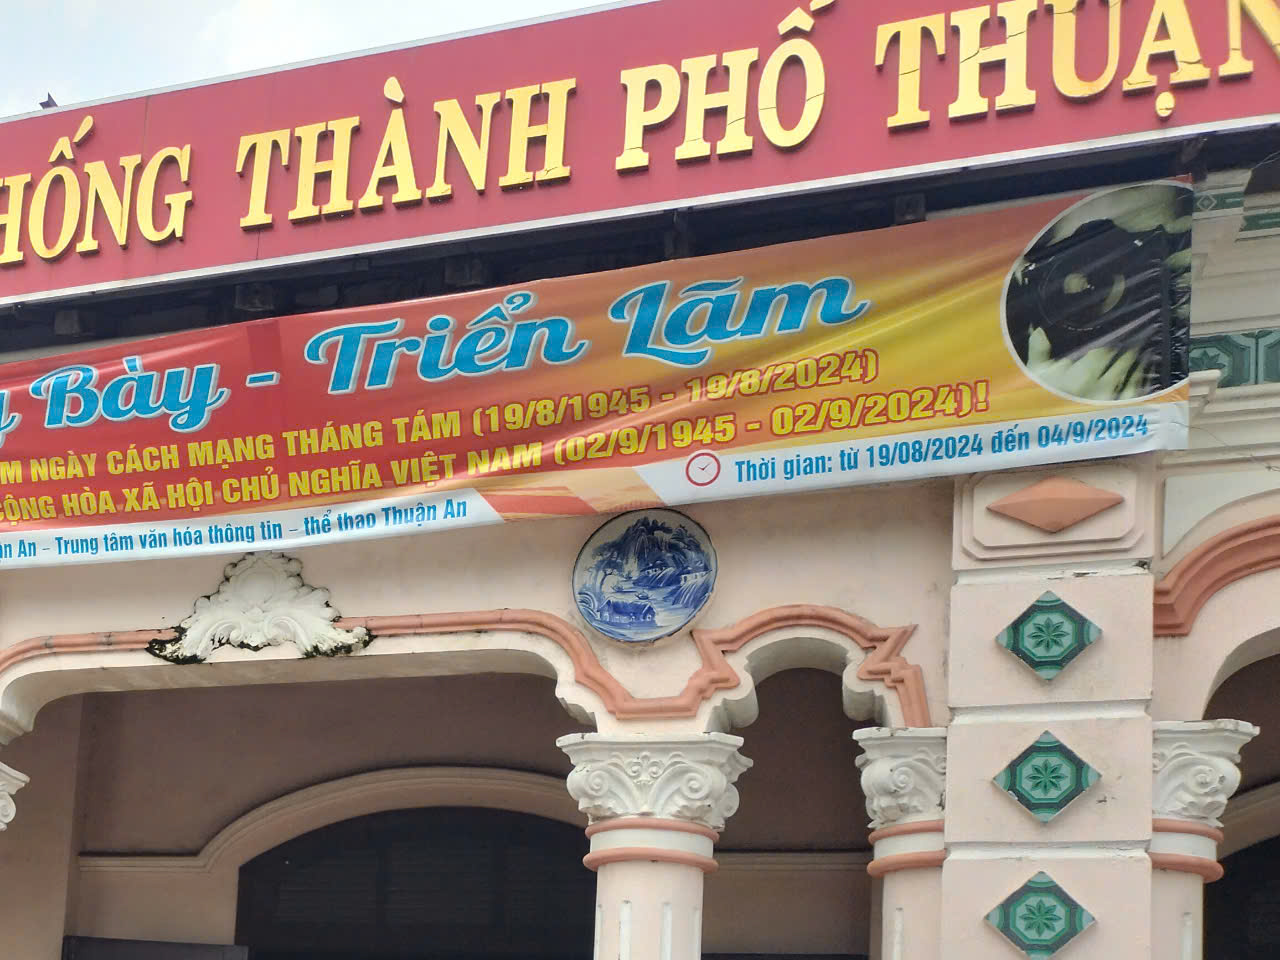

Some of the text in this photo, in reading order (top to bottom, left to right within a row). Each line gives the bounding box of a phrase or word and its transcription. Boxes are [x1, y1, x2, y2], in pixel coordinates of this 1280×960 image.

[236, 77, 576, 230] THÀNH
[616, 0, 836, 170] PHỐ
[30, 355, 227, 432] Bày
[248, 368, 281, 387] -
[305, 291, 588, 396] Triển
[610, 275, 869, 368] Lãm
[30, 451, 97, 481] NGÀY
[107, 444, 180, 475] CÁCH
[188, 434, 274, 469] MẠNG
[282, 421, 384, 456] THÁNG
[392, 410, 461, 443] TÁM
[470, 385, 652, 438] (19/8/1945
[685, 349, 879, 403] 19/8/2024)
[62, 486, 117, 517] HÒA
[122, 481, 161, 513] XÃ
[167, 476, 214, 512] HỘI
[222, 466, 280, 503] CHỦ
[288, 459, 383, 497] NGHĨA
[390, 451, 457, 488] VIỆT
[467, 441, 543, 476] NAM
[553, 414, 737, 466] (02/9/1945
[770, 378, 991, 437] 02/9/2024)!
[735, 413, 1149, 484] Thời gian: từ 19/08/2024 đến 04/9/2024
[17, 539, 37, 558] An
[55, 536, 99, 556] Trung
[103, 532, 134, 552] tâm
[139, 529, 168, 549] văn
[173, 526, 203, 547] hóa
[208, 523, 255, 546] thông
[260, 520, 283, 541] tin
[304, 509, 332, 536] thể
[337, 511, 377, 533] thao
[381, 502, 437, 527] Thuận
[443, 499, 467, 520] An
